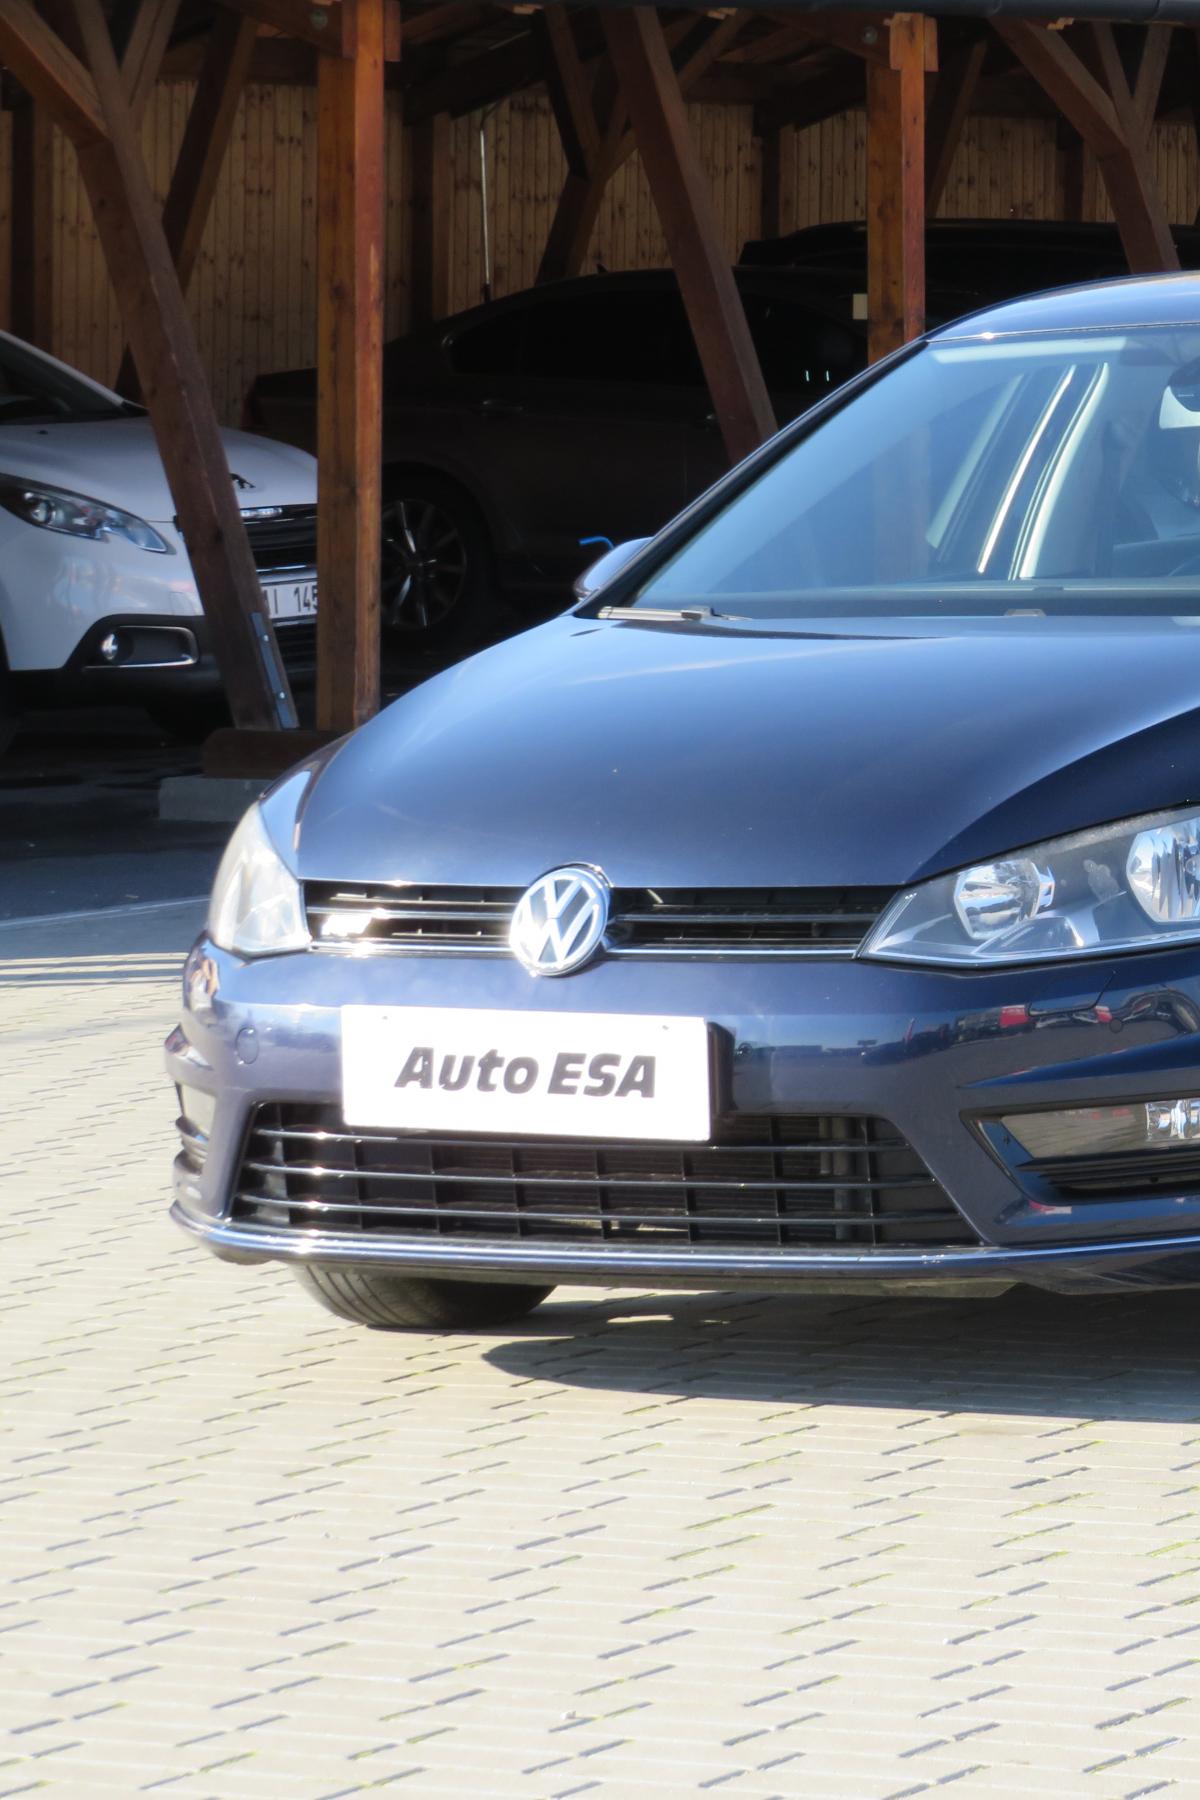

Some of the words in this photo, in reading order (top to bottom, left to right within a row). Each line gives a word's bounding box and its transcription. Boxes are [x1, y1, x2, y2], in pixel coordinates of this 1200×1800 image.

[511, 869, 606, 974] VW
[393, 1046, 540, 1095] Auto
[547, 1052, 657, 1099] ESA
